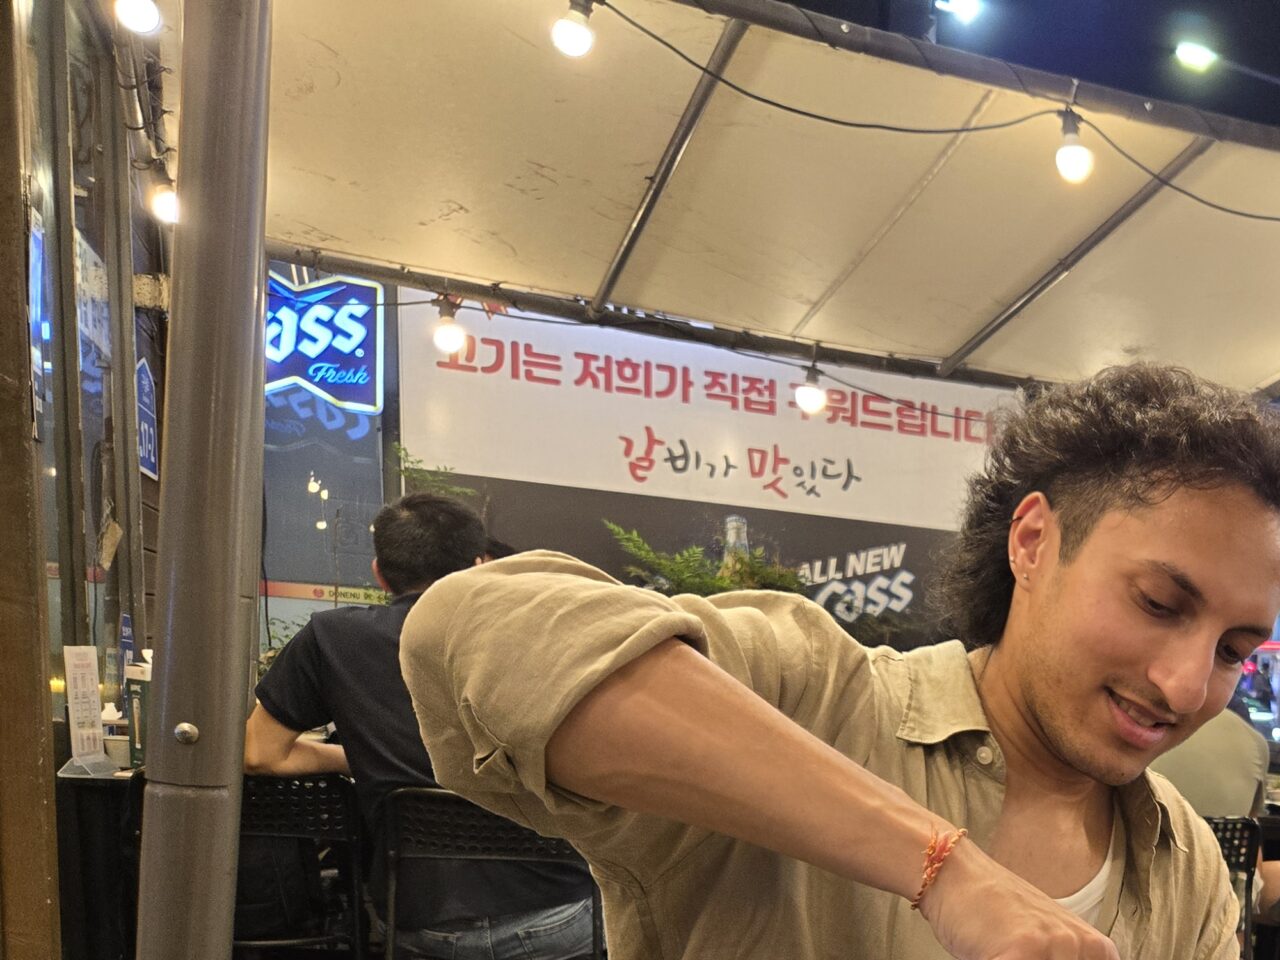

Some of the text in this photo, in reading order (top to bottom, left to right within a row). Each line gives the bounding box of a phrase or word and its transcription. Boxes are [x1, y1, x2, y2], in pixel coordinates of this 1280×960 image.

[308, 362, 370, 384] Fresh
[436, 332, 562, 386] 고기는
[573, 350, 694, 404] 저희가
[703, 369, 777, 417] 직접
[618, 425, 862, 499] 갈비가 맛있다
[798, 542, 907, 586] ALL NEW
